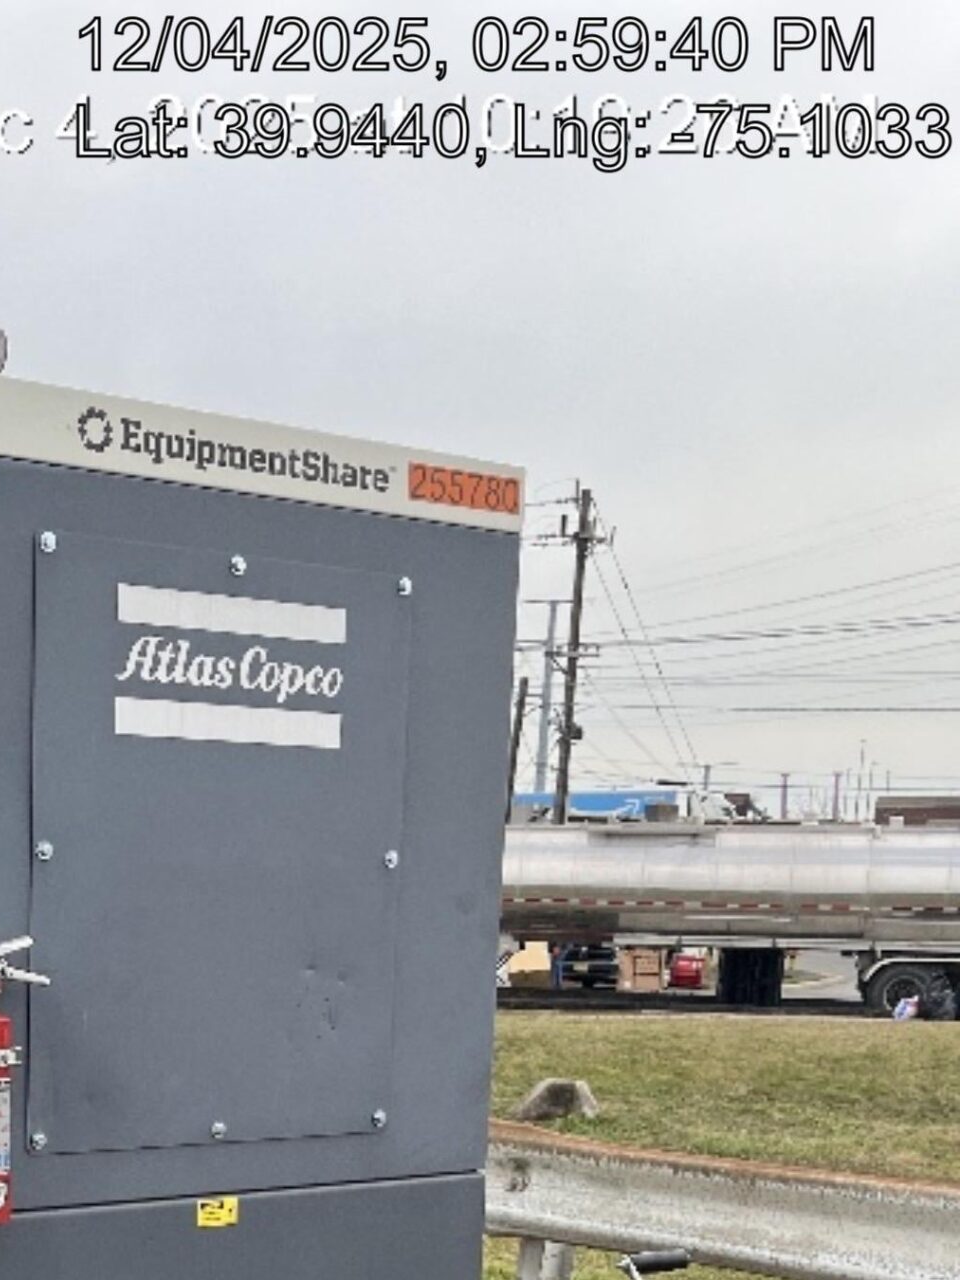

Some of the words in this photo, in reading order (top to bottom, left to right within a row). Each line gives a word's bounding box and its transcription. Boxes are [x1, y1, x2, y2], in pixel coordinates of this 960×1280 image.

[119, 416, 392, 494] EquipmentShare
[409, 463, 519, 514] 255780
[116, 635, 237, 691] Atlas
[239, 645, 344, 704] Copco
